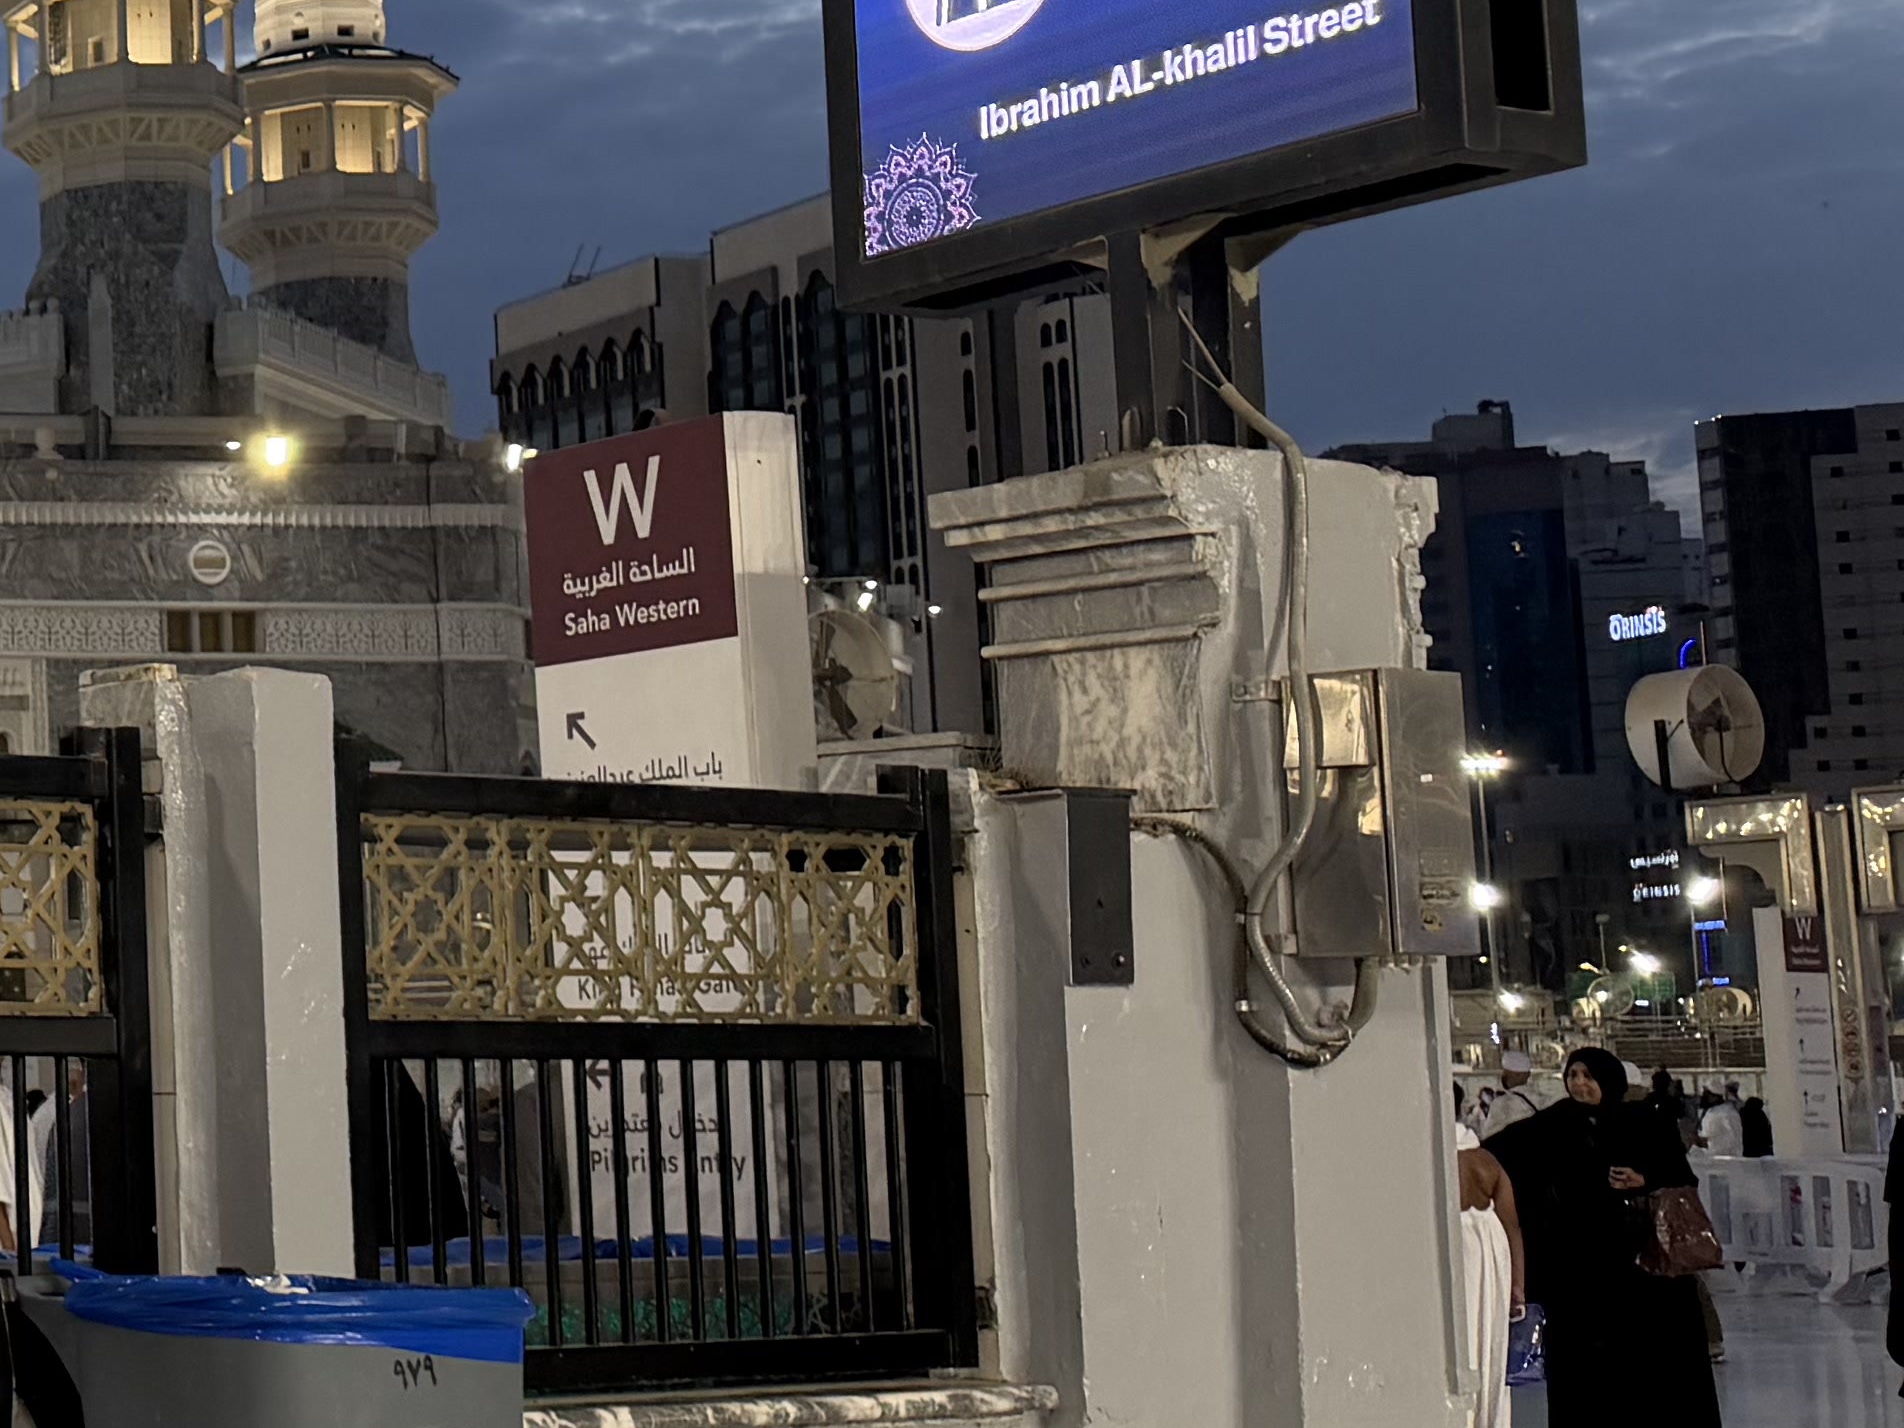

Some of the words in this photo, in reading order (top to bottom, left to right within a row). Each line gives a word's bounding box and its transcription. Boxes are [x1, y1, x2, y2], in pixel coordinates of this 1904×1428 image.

[978, 78, 1101, 141] Ibrahim
[1106, 24, 1257, 104] AL-khalil
[583, 455, 660, 546] W
[562, 559, 625, 599] الغربية
[628, 546, 696, 584] الساحة
[564, 608, 611, 637] Saha
[615, 597, 701, 628] Western
[638, 755, 689, 783] الملك
[693, 751, 723, 783] باب
